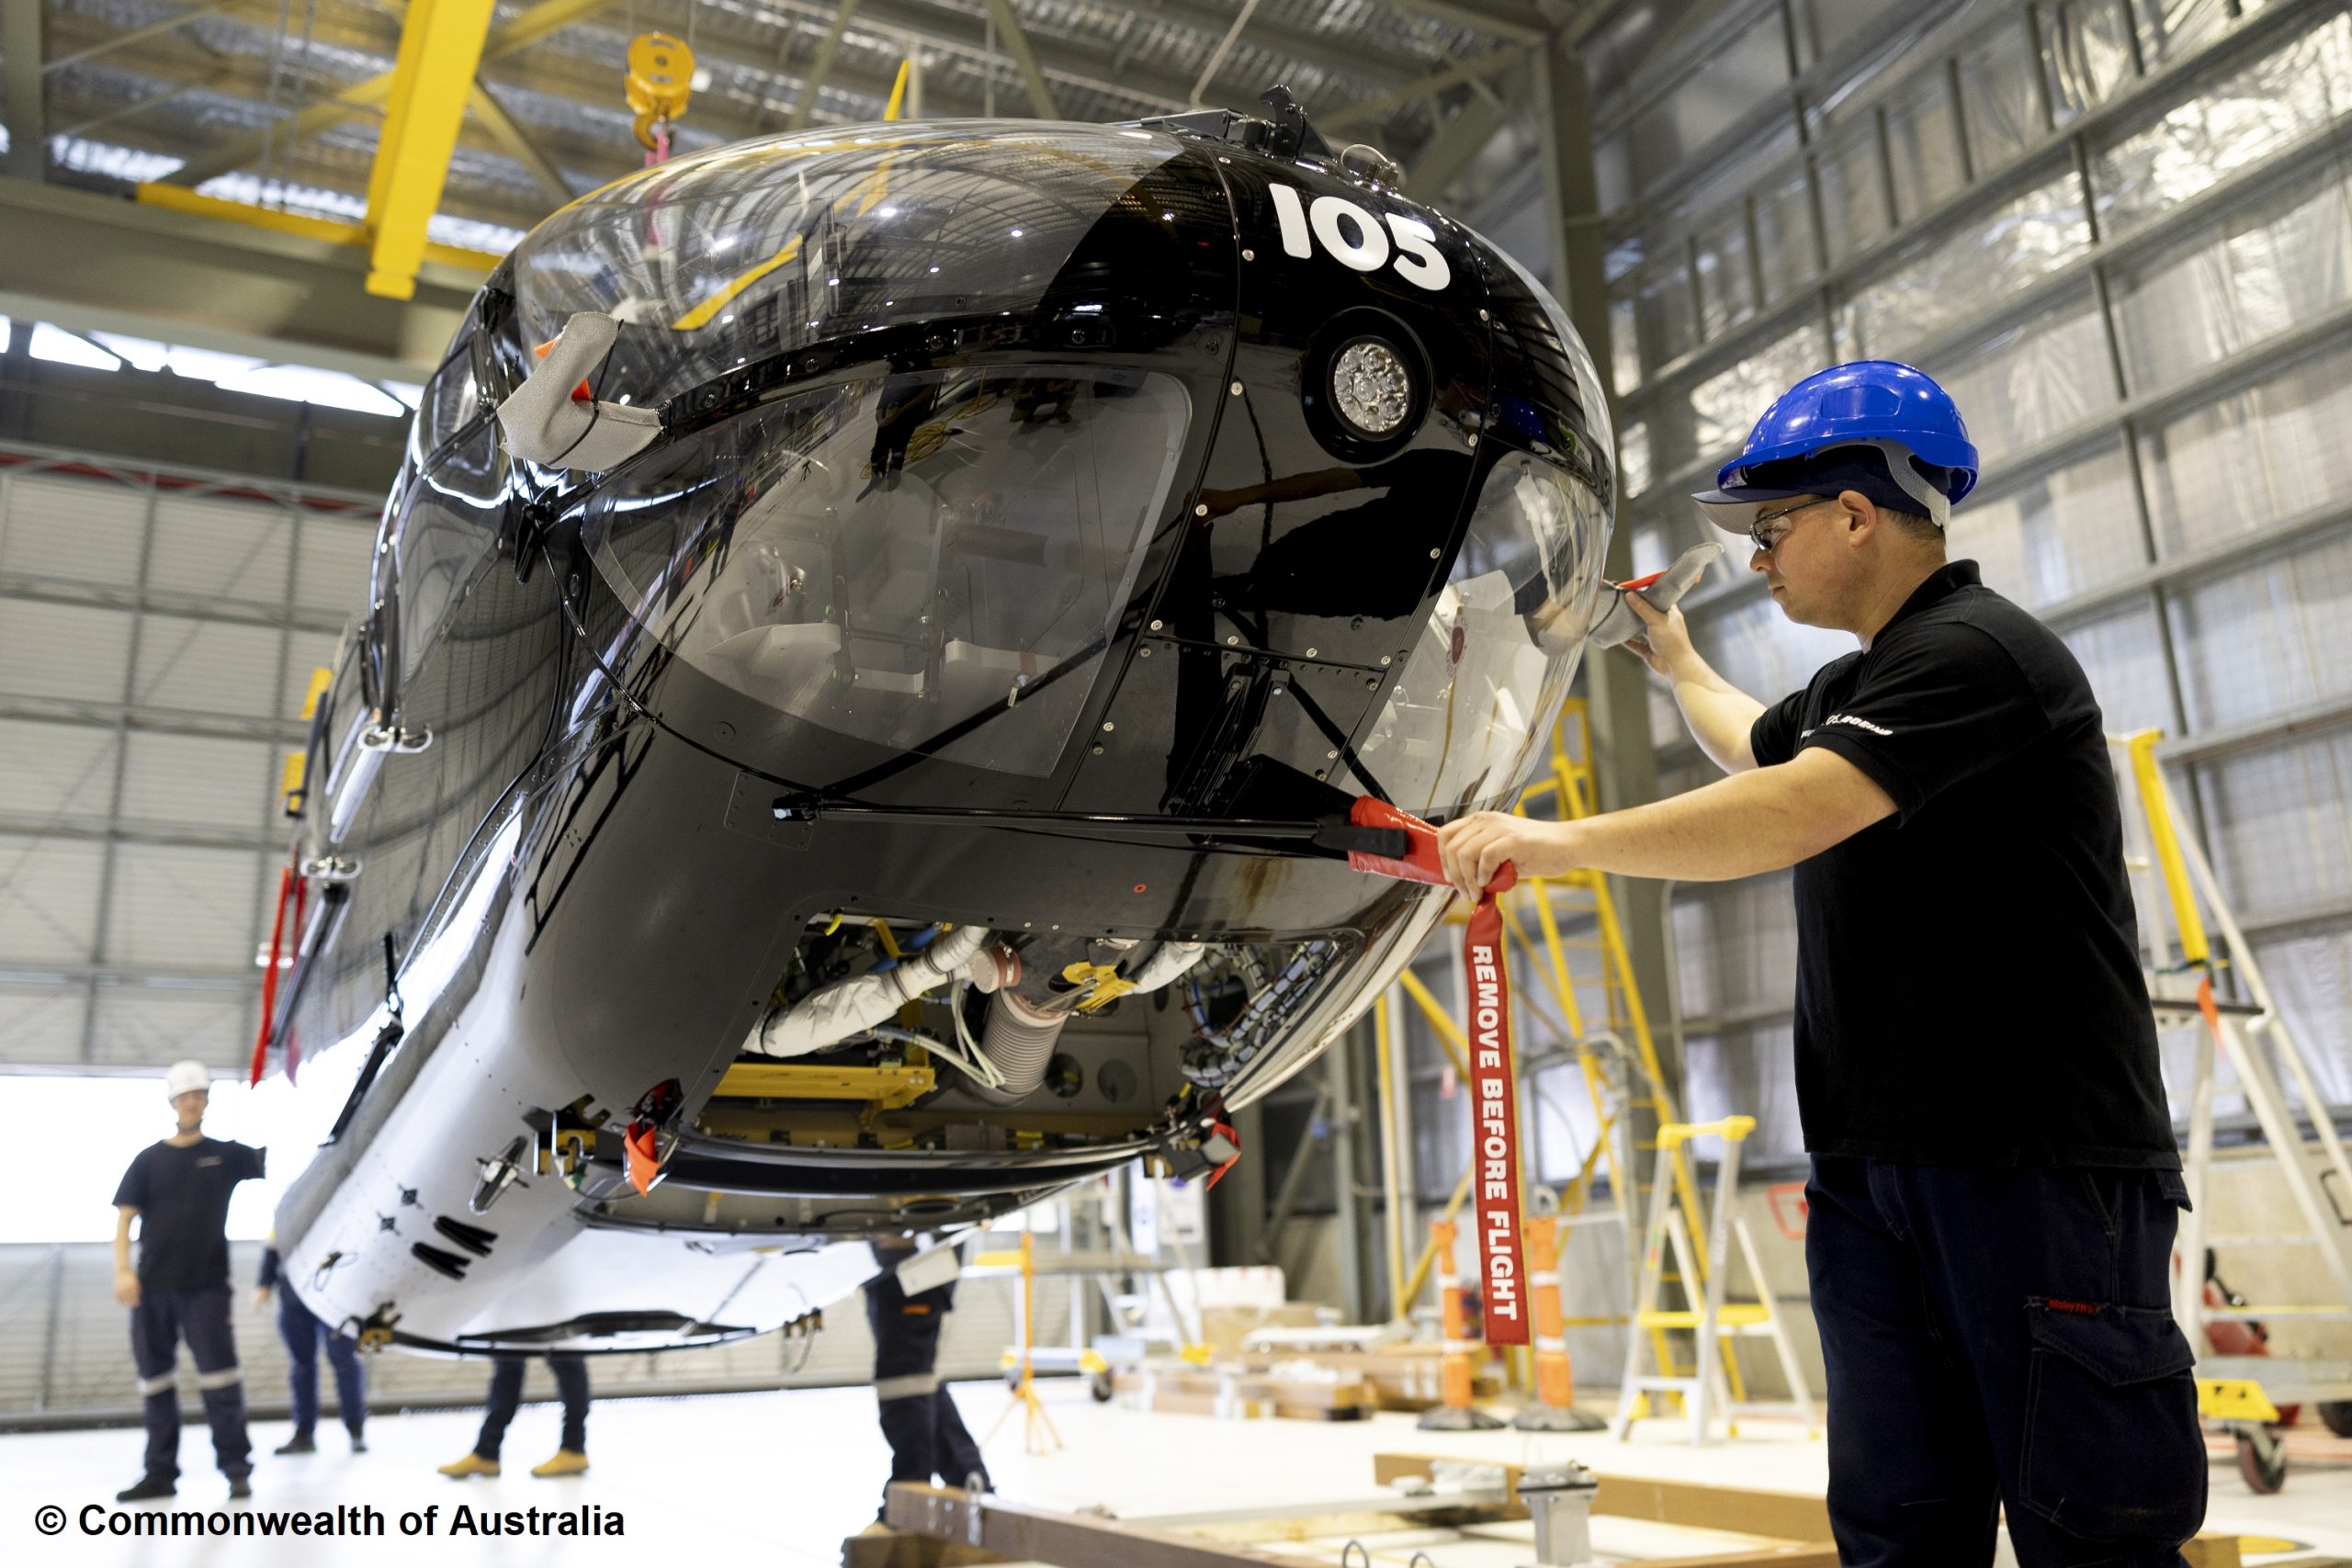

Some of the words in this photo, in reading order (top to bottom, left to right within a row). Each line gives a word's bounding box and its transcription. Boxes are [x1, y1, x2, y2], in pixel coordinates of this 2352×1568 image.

[1269, 183, 1451, 291] 105
[1473, 945, 1500, 1068] REMOVE
[1482, 1078, 1508, 1200] BEFORE
[1487, 1211, 1517, 1320] FLIGHT
